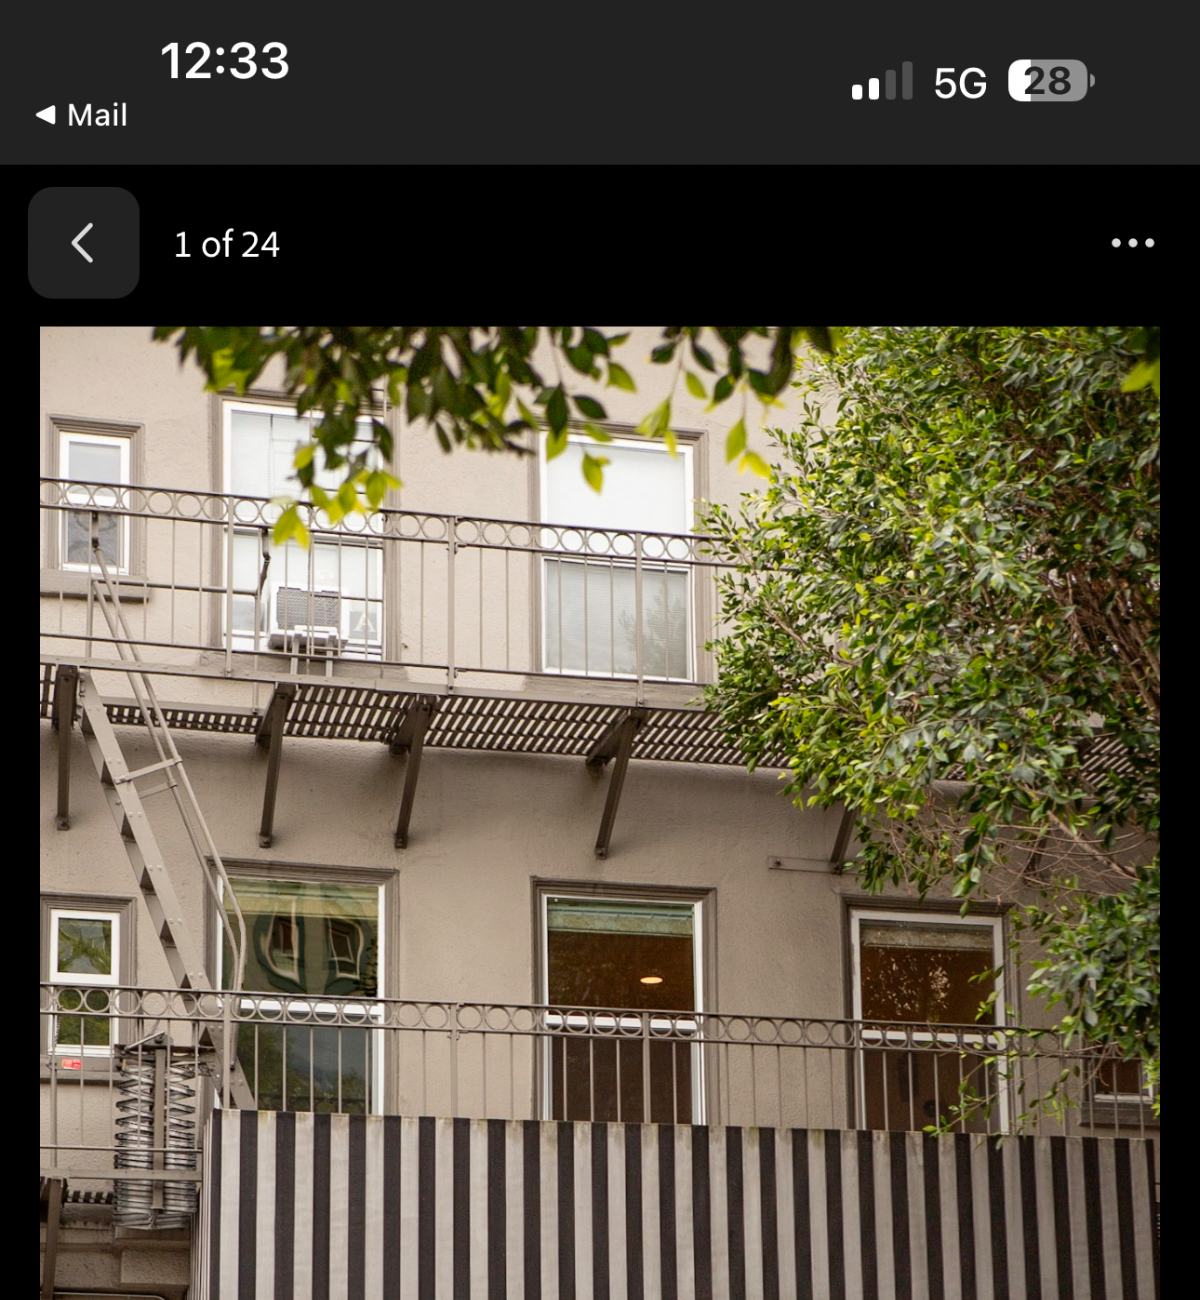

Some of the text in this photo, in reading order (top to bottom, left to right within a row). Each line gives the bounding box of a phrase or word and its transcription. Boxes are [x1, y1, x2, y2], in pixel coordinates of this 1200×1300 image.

[161, 41, 289, 80] 12:33
[934, 66, 987, 100] 5G
[1024, 66, 1071, 95] 28
[68, 101, 127, 127] Mail
[175, 228, 280, 258] 1 of 24
